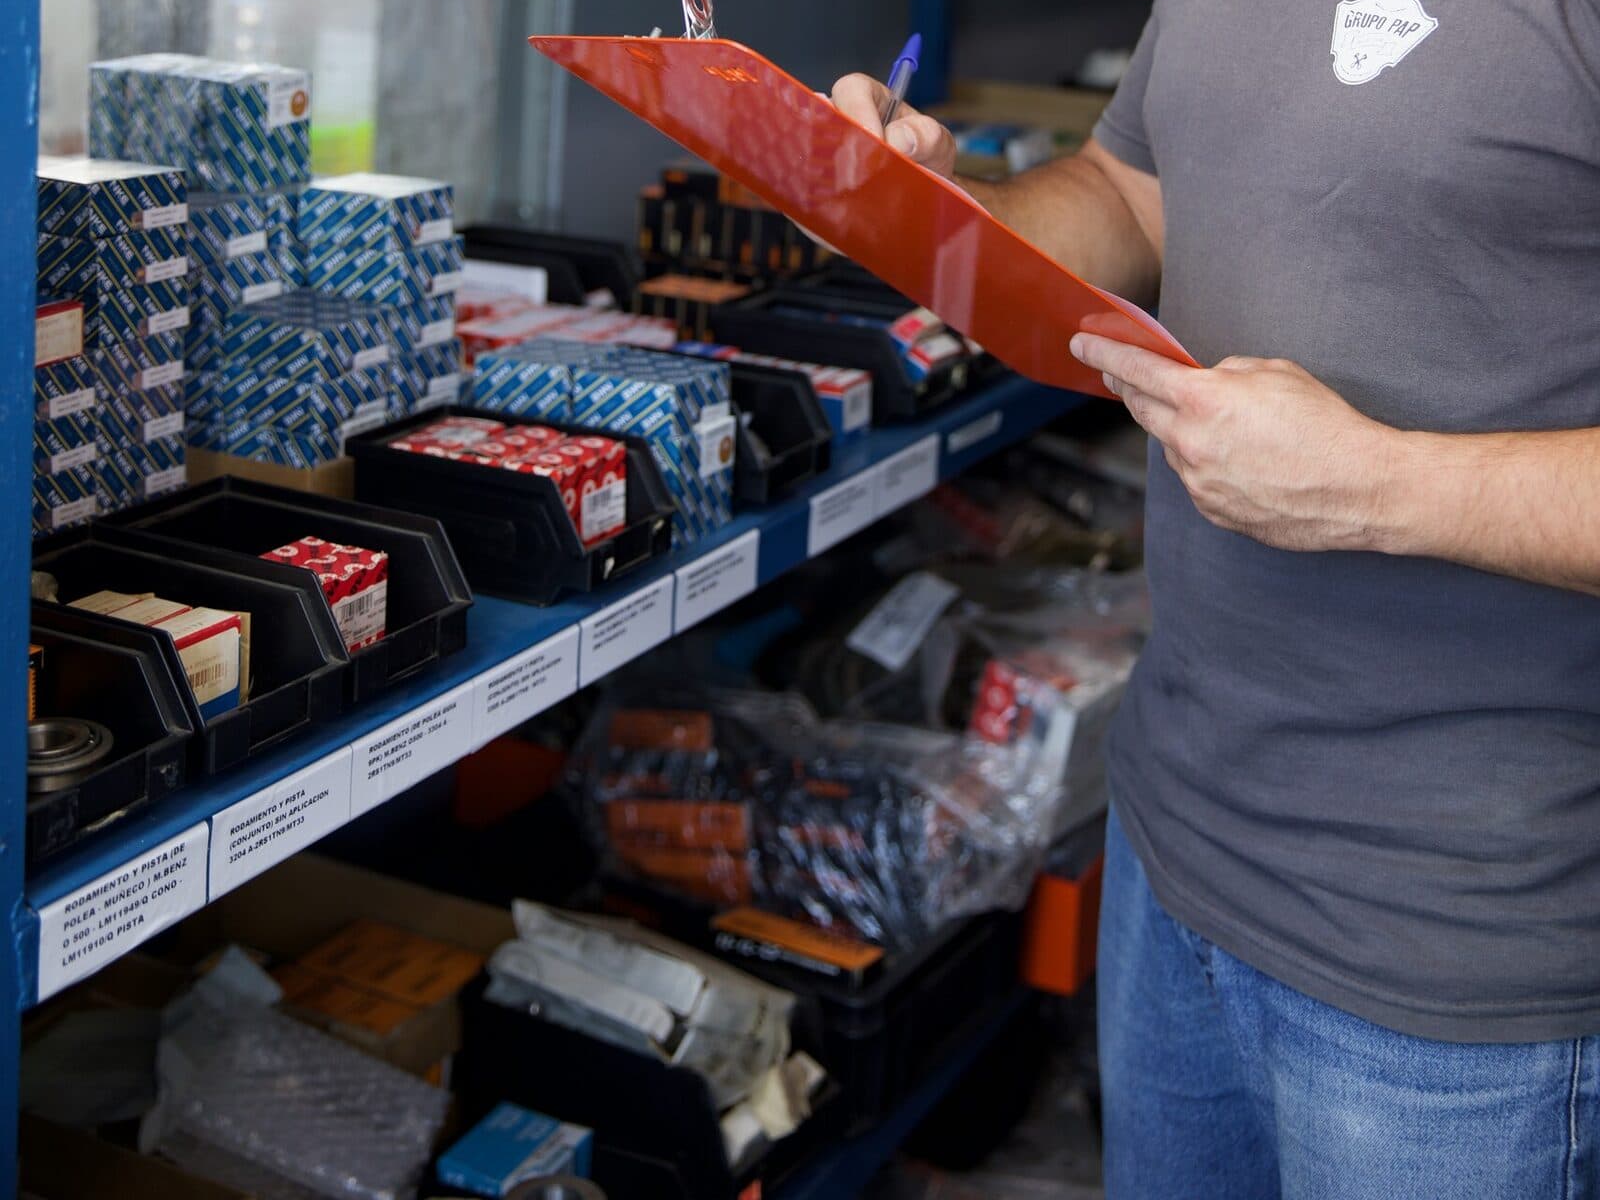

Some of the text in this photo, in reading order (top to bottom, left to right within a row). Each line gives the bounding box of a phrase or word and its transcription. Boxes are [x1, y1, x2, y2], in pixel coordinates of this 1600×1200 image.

[1344, 10, 1421, 38] GRUPO PAP
[369, 727, 409, 753] RODAMIENTO
[422, 711, 441, 724] POLEA
[230, 805, 277, 836] RODAMIENTO
[285, 789, 305, 805] PISTA
[230, 789, 329, 851] (CONJUNTO) SIN APLICACION
[229, 849, 246, 864] 3204
[64, 843, 186, 914] RODAMIENTO Y PISTA (DE
[64, 908, 96, 931] POLEA
[153, 858, 187, 881] M.BENZ
[73, 927, 90, 943] 500
[117, 914, 145, 936] PISTA
